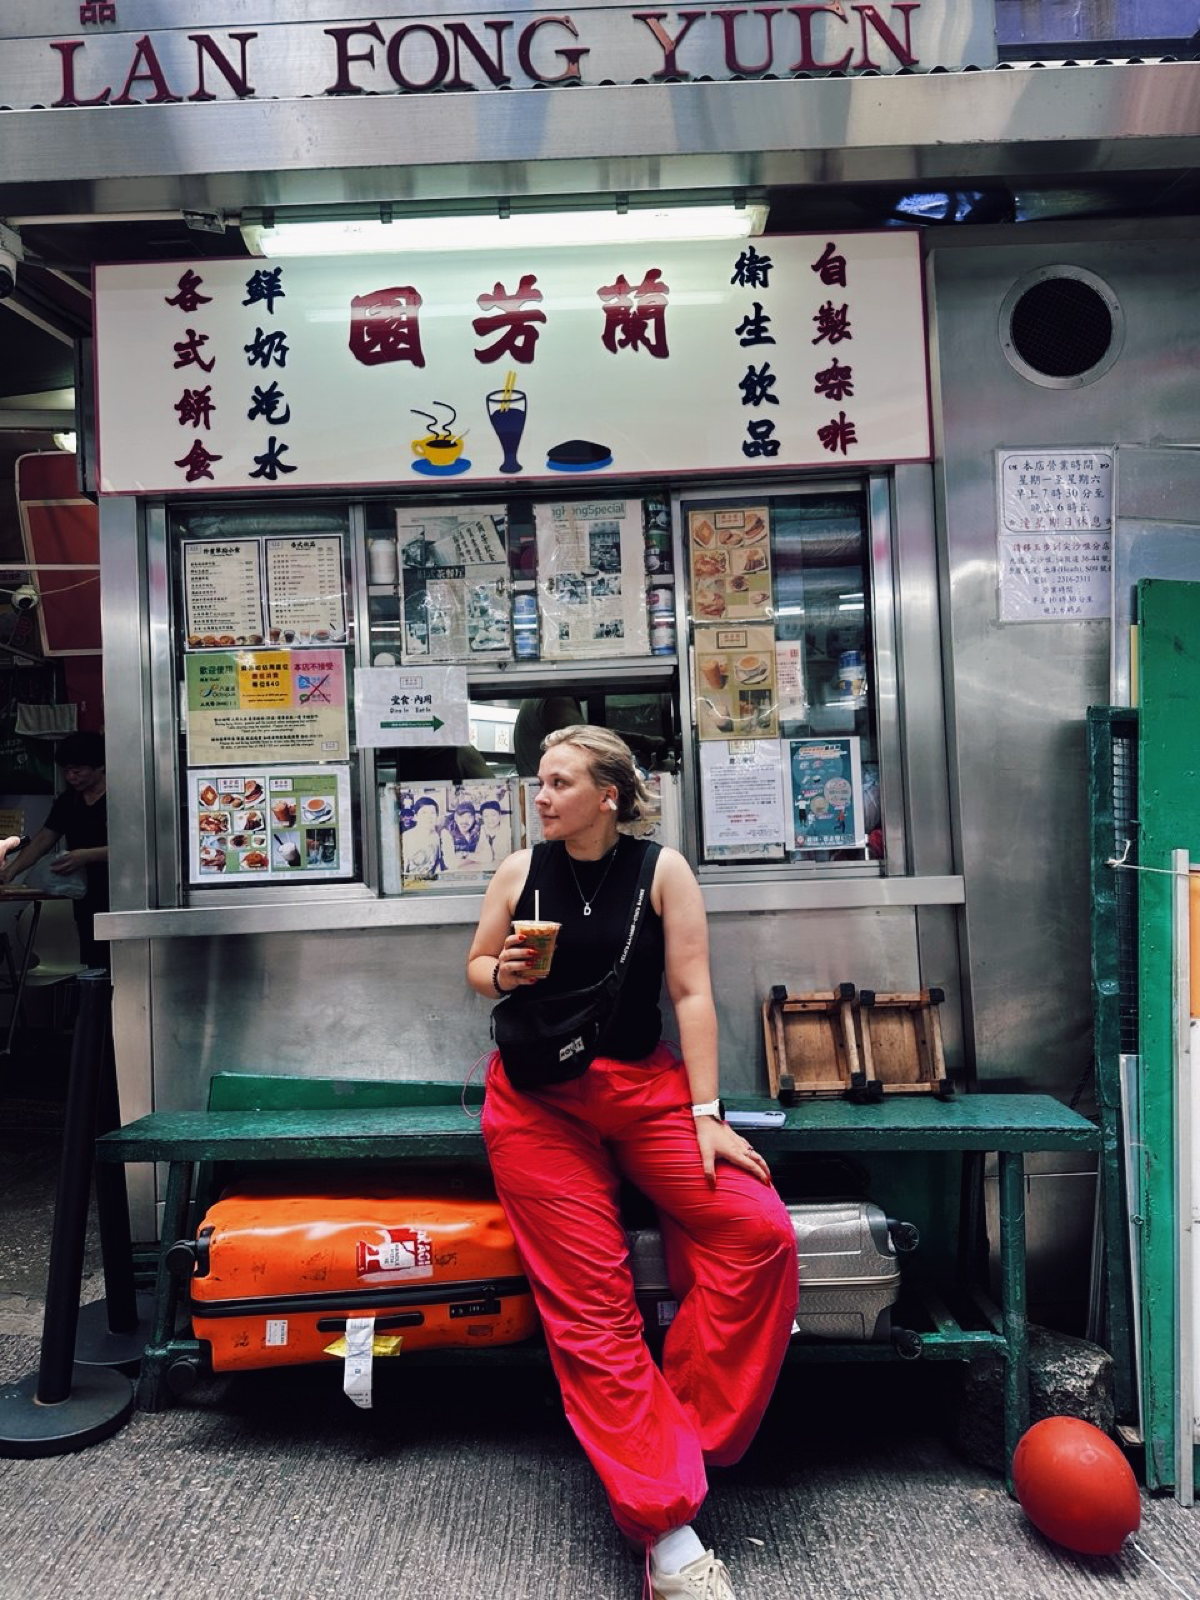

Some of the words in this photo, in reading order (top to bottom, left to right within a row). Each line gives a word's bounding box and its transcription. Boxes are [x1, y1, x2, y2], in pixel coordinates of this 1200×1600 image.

[50, 32, 258, 107] LAN
[323, 15, 591, 95] FONG
[632, 2, 921, 77] YUEN
[164, 268, 223, 482] 各式餅食
[1018, 474, 1101, 486] 星期一至星期六
